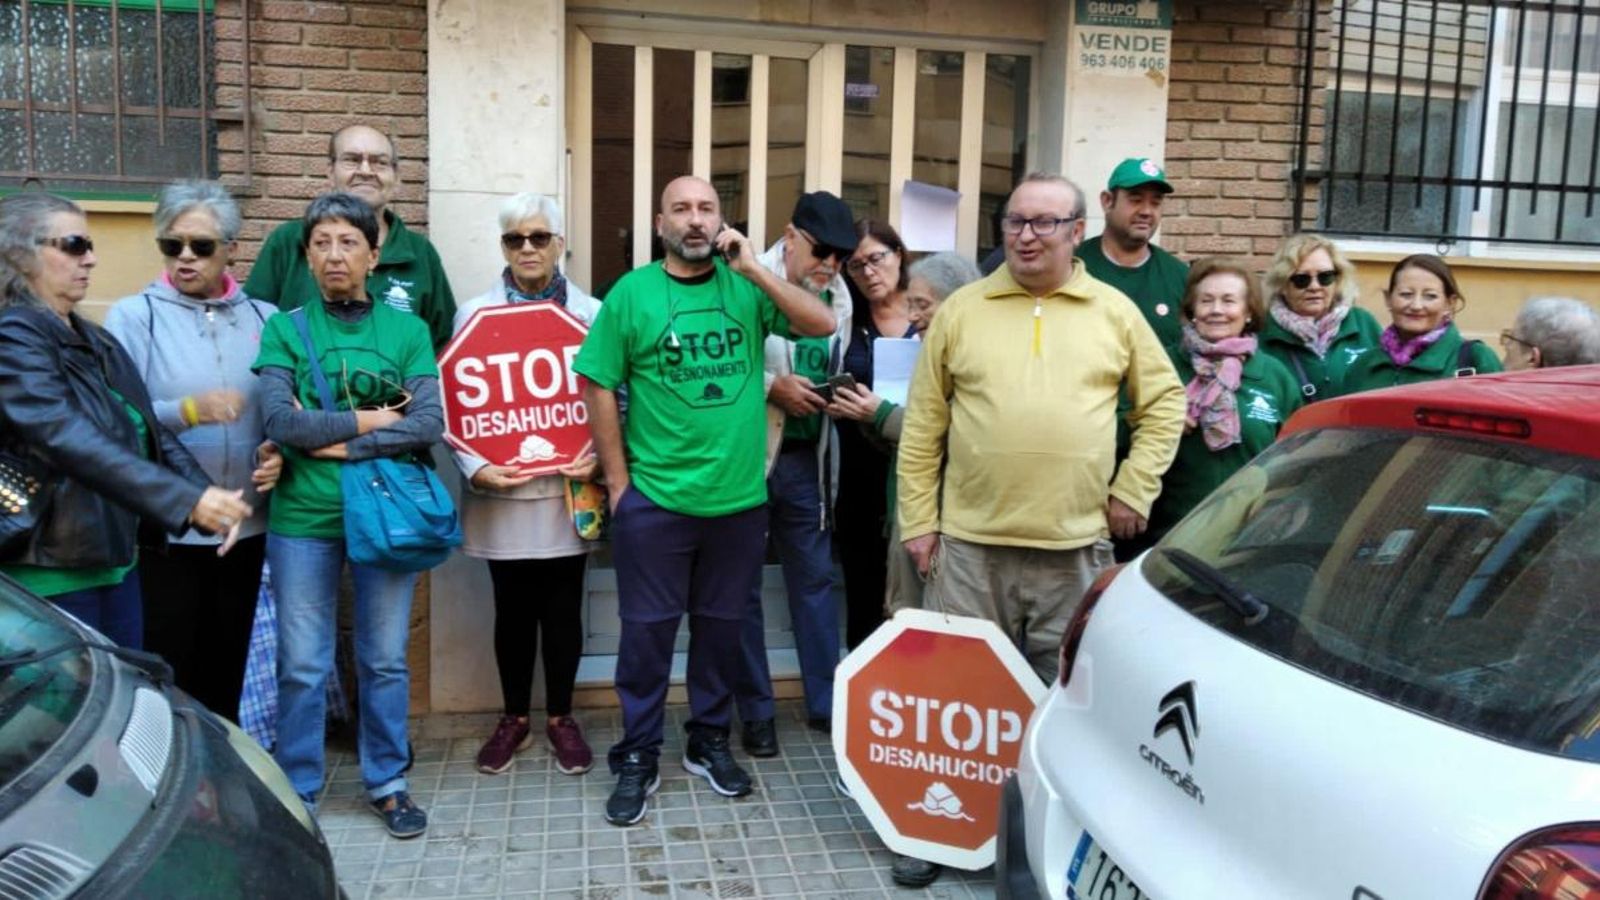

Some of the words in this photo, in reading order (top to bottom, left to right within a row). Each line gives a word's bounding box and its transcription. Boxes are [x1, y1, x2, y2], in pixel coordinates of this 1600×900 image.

[1087, 1, 1136, 16] GRUPO
[1080, 32, 1167, 53] VENDE
[1080, 53, 1106, 68] 963
[1139, 57, 1166, 71] 406
[663, 327, 743, 366] STOP
[461, 400, 589, 440] DESAHUCIO
[869, 689, 1022, 756] STOP
